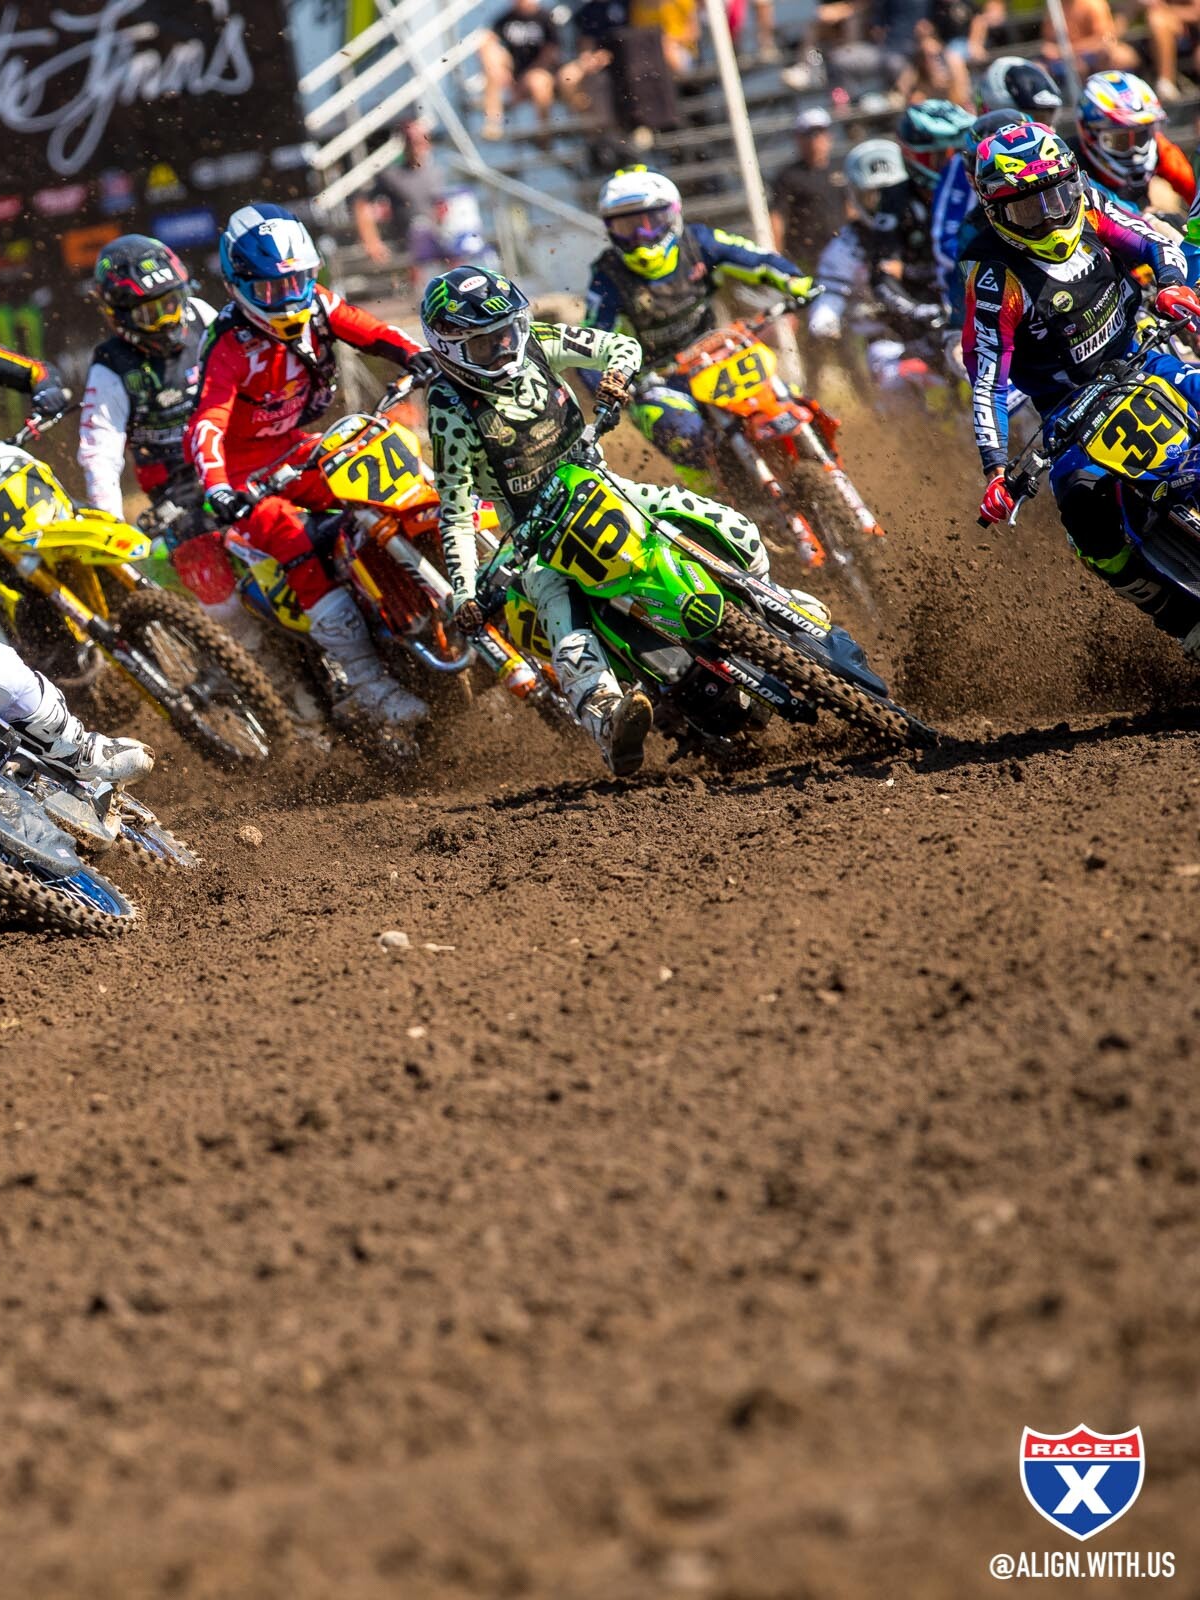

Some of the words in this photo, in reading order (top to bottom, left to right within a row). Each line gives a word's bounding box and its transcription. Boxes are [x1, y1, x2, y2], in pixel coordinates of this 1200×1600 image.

[141, 267, 174, 288] FLY
[713, 352, 768, 401] 49
[1102, 382, 1182, 477] 39
[347, 433, 420, 502] 24
[560, 489, 631, 582] 15
[755, 594, 828, 638] DUNLOP
